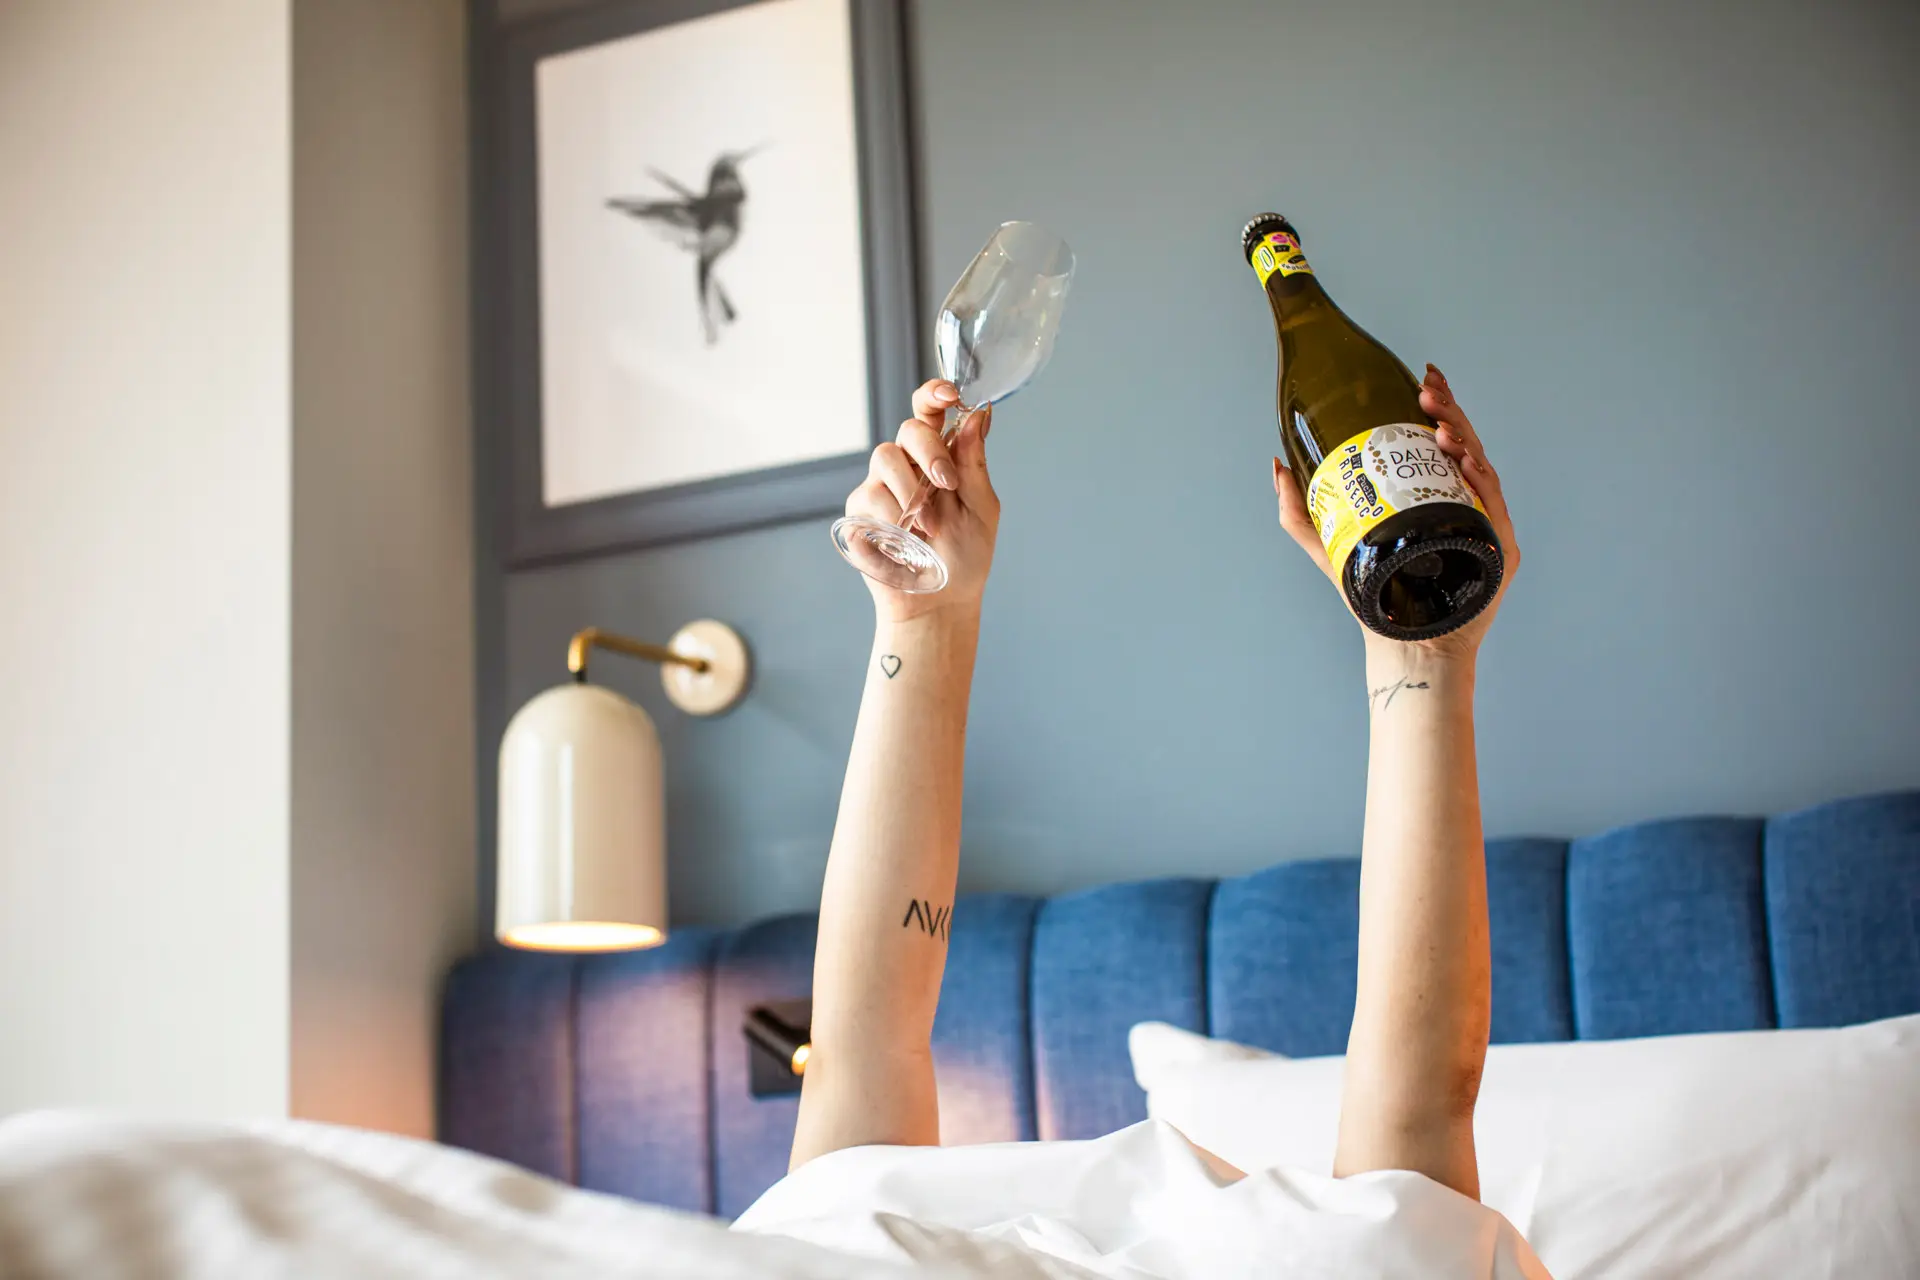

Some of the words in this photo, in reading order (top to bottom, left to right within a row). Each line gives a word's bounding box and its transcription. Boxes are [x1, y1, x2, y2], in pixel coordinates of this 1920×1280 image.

[1389, 448, 1441, 465] DALZ
[1396, 462, 1448, 479] OTTO
[1339, 445, 1384, 518] PROSECCO
